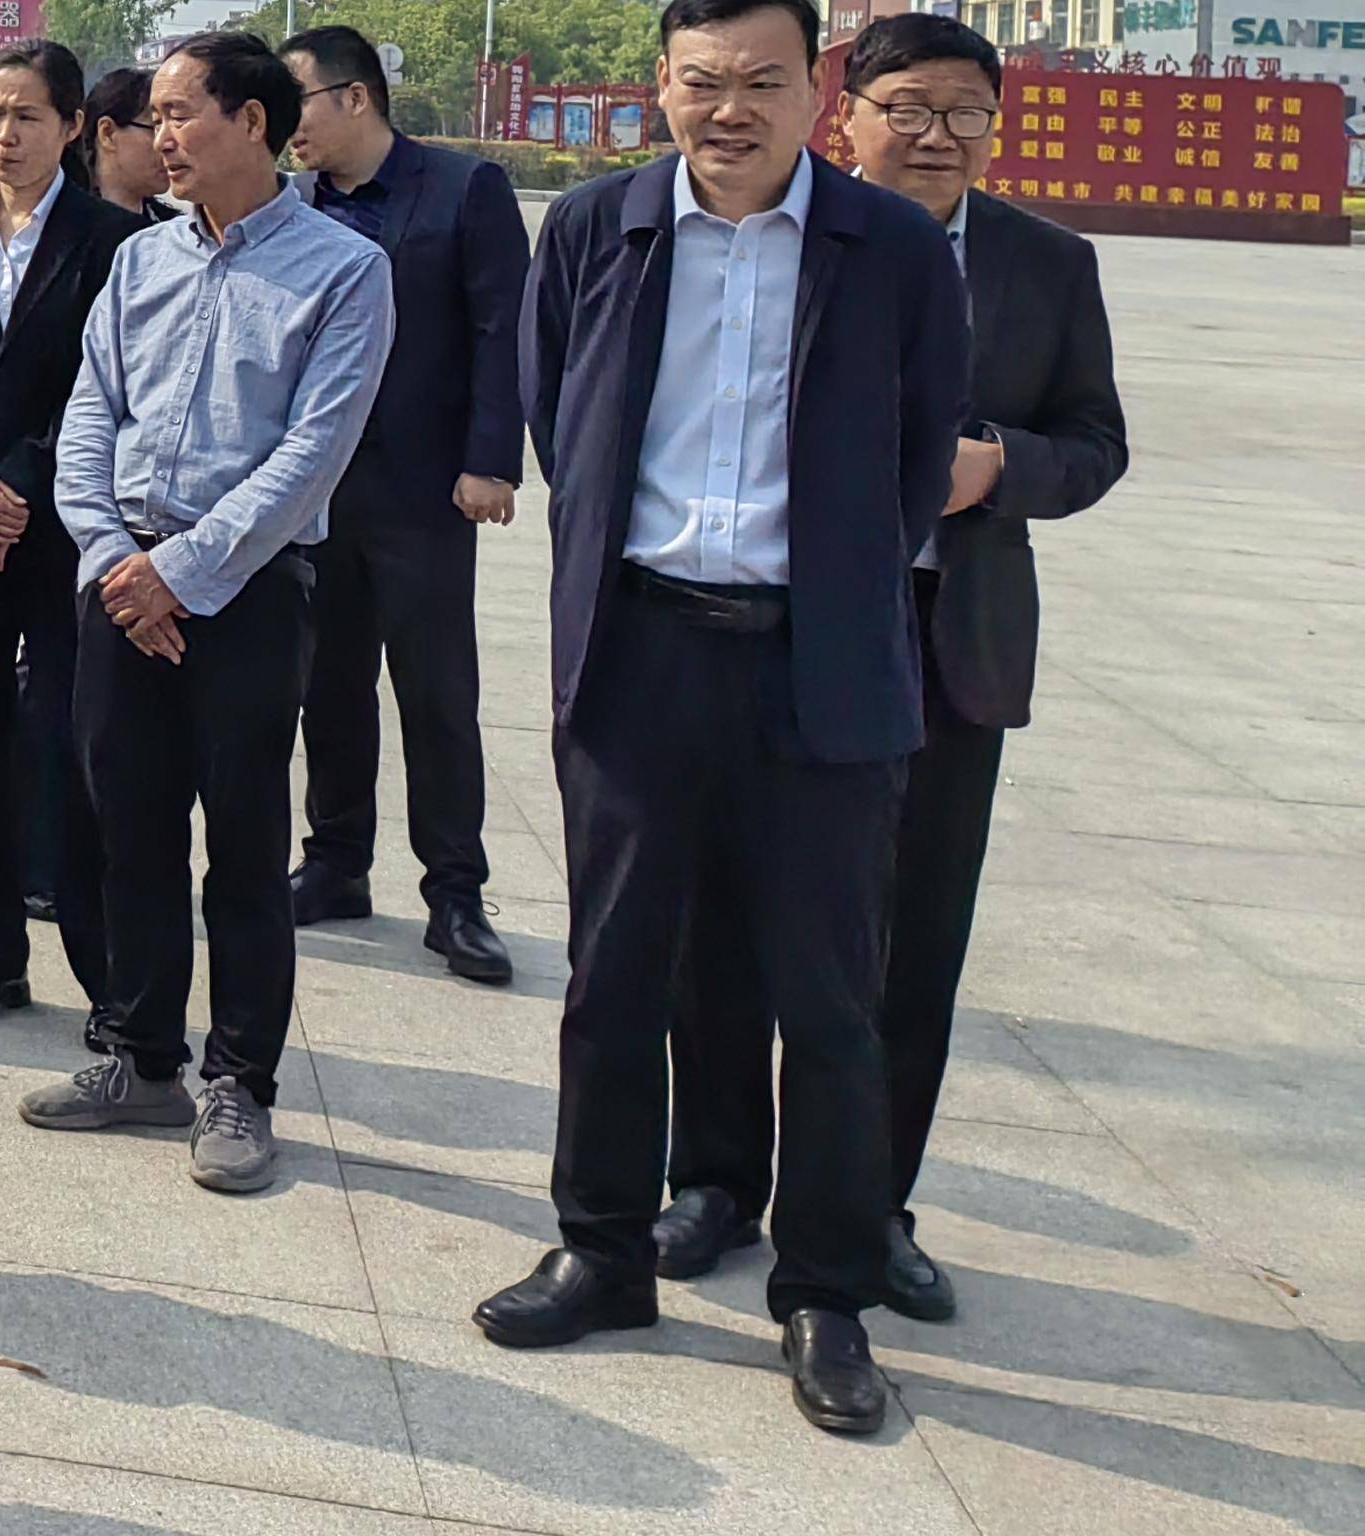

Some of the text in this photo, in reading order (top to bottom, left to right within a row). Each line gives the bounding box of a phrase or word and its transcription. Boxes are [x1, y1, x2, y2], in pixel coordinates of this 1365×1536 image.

[1023, 85, 1302, 116] 富强 民主 文明 和谐
[1022, 114, 1300, 144] 自由 平等 公正 法治
[1020, 140, 1300, 172] 爱国 敬业 诚信 友善
[1114, 183, 1322, 212] 共建幸福美好家园
